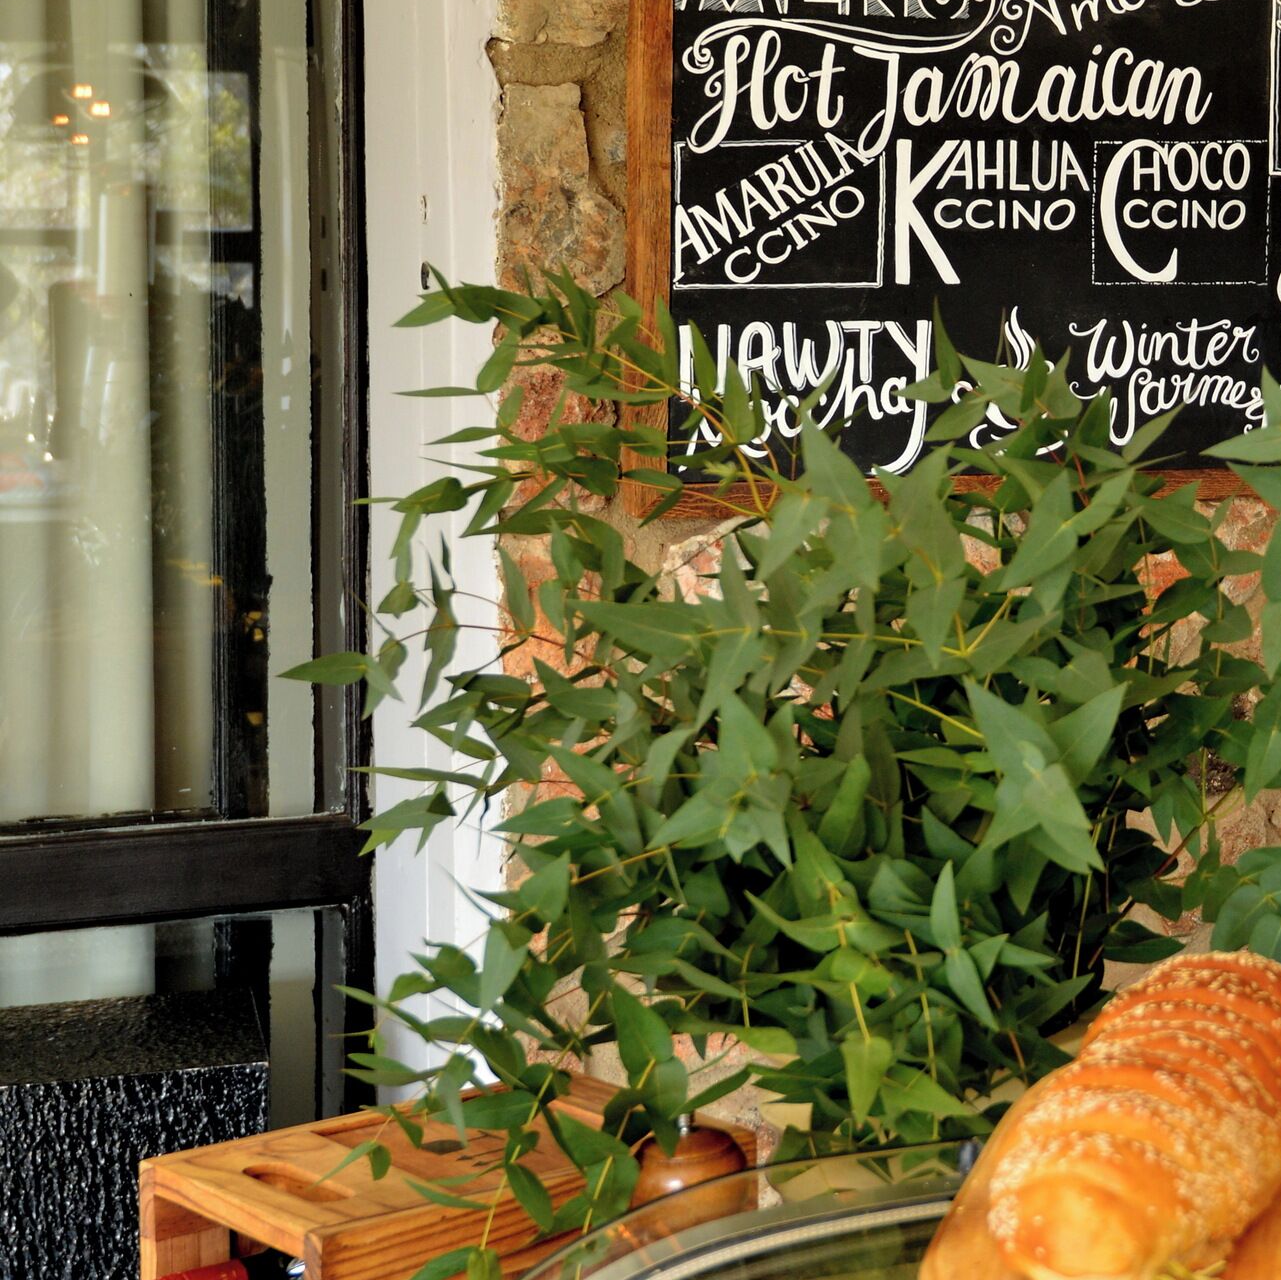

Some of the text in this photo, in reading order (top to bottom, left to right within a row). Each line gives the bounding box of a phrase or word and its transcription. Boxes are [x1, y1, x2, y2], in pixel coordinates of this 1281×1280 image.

[686, 30, 1212, 160] Hot Jamaican
[674, 131, 876, 282] AMARULA
[724, 185, 865, 283] CCINO
[895, 139, 1090, 285] KAHLUA
[933, 199, 1076, 231] CCINO
[1100, 139, 1251, 282] CHOCO
[1122, 199, 1246, 231] CCINO
[1069, 318, 1260, 382] Winter
